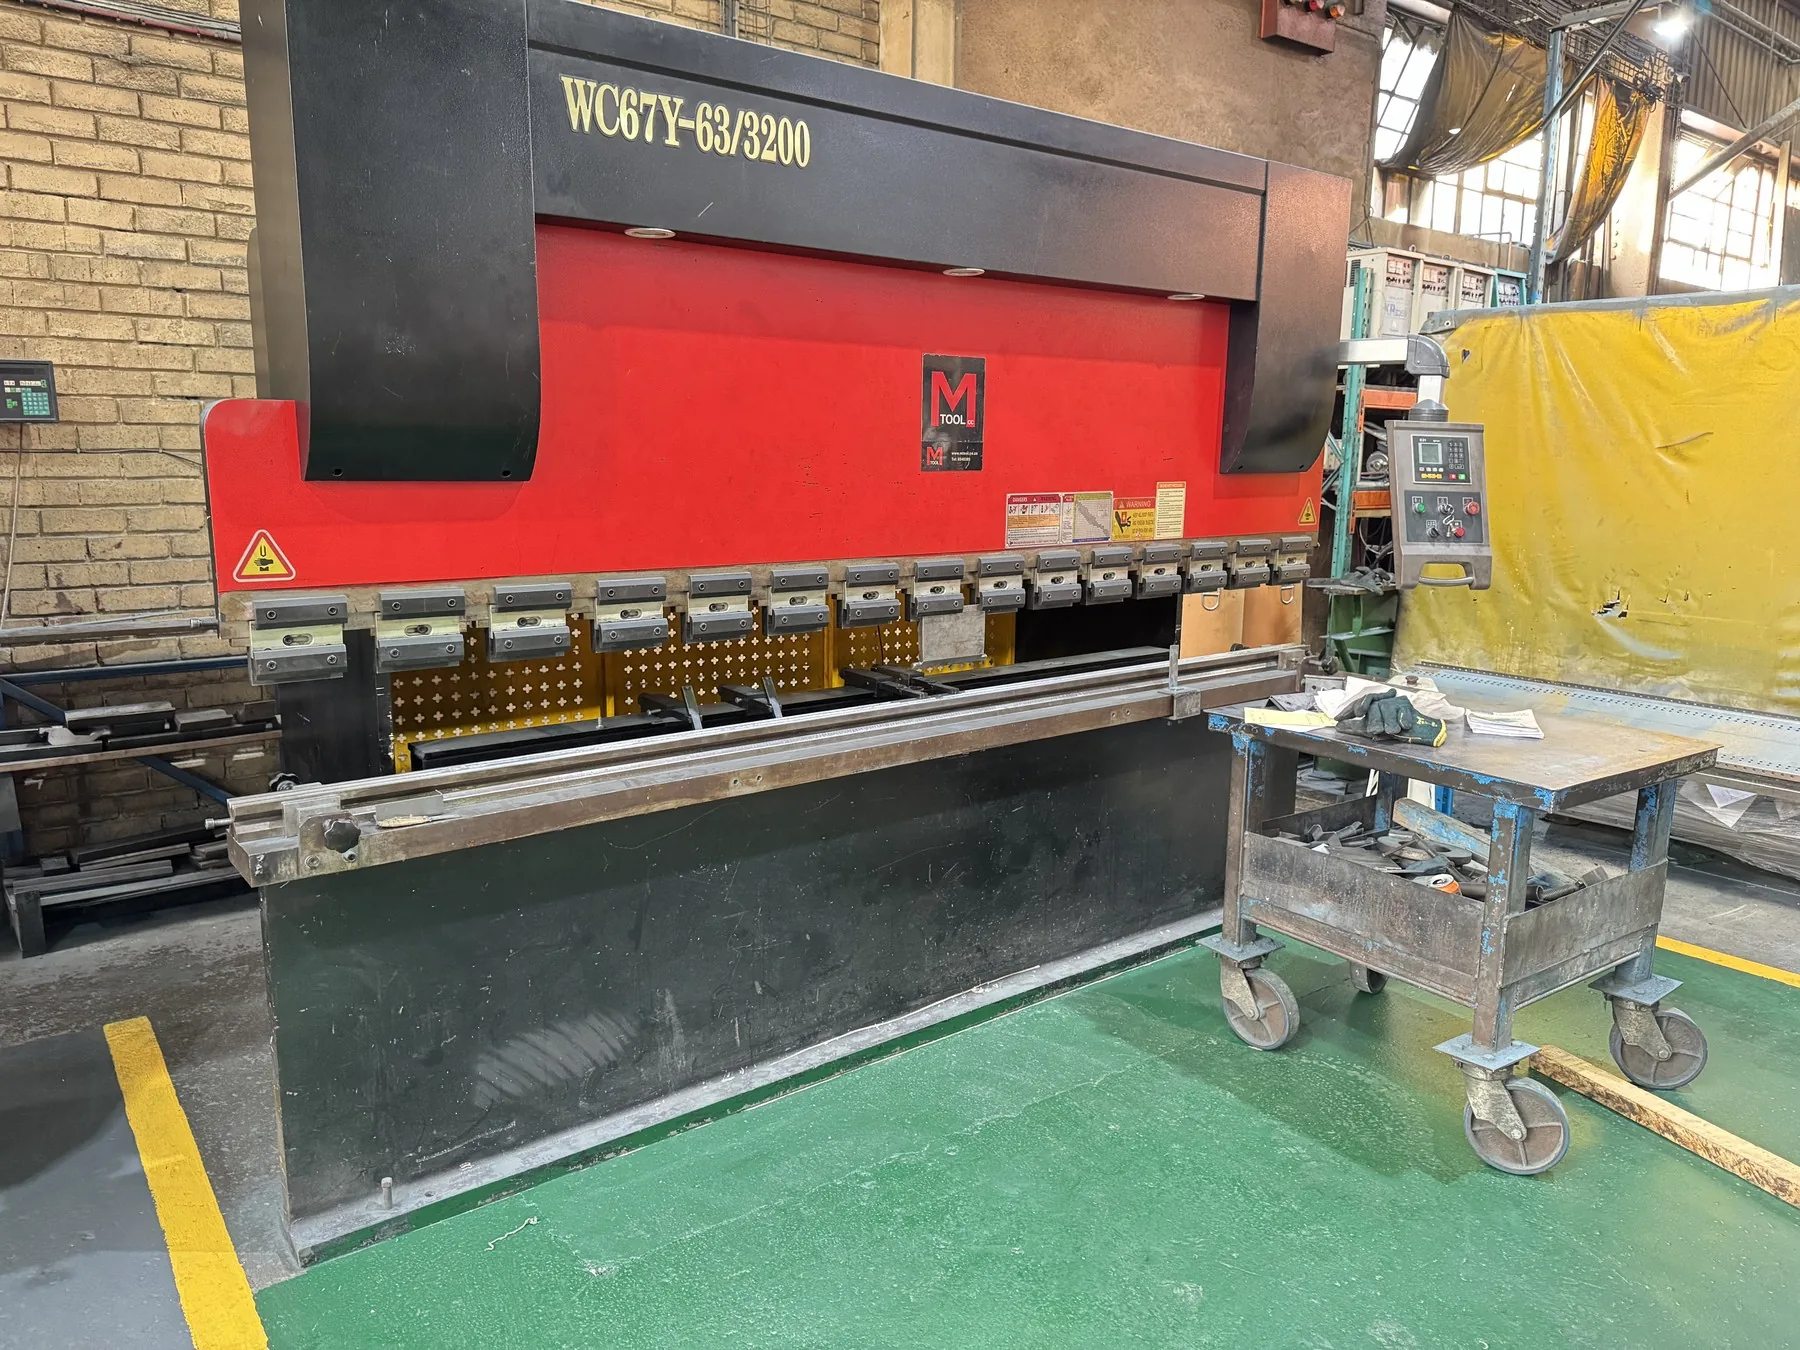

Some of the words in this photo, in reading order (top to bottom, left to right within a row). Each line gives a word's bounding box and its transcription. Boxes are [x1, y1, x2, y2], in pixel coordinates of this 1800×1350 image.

[560, 76, 811, 168] WC67Y-63/3200
[930, 370, 977, 428] M
[940, 414, 966, 425] TOOL
[1126, 500, 1152, 508] WARNING
